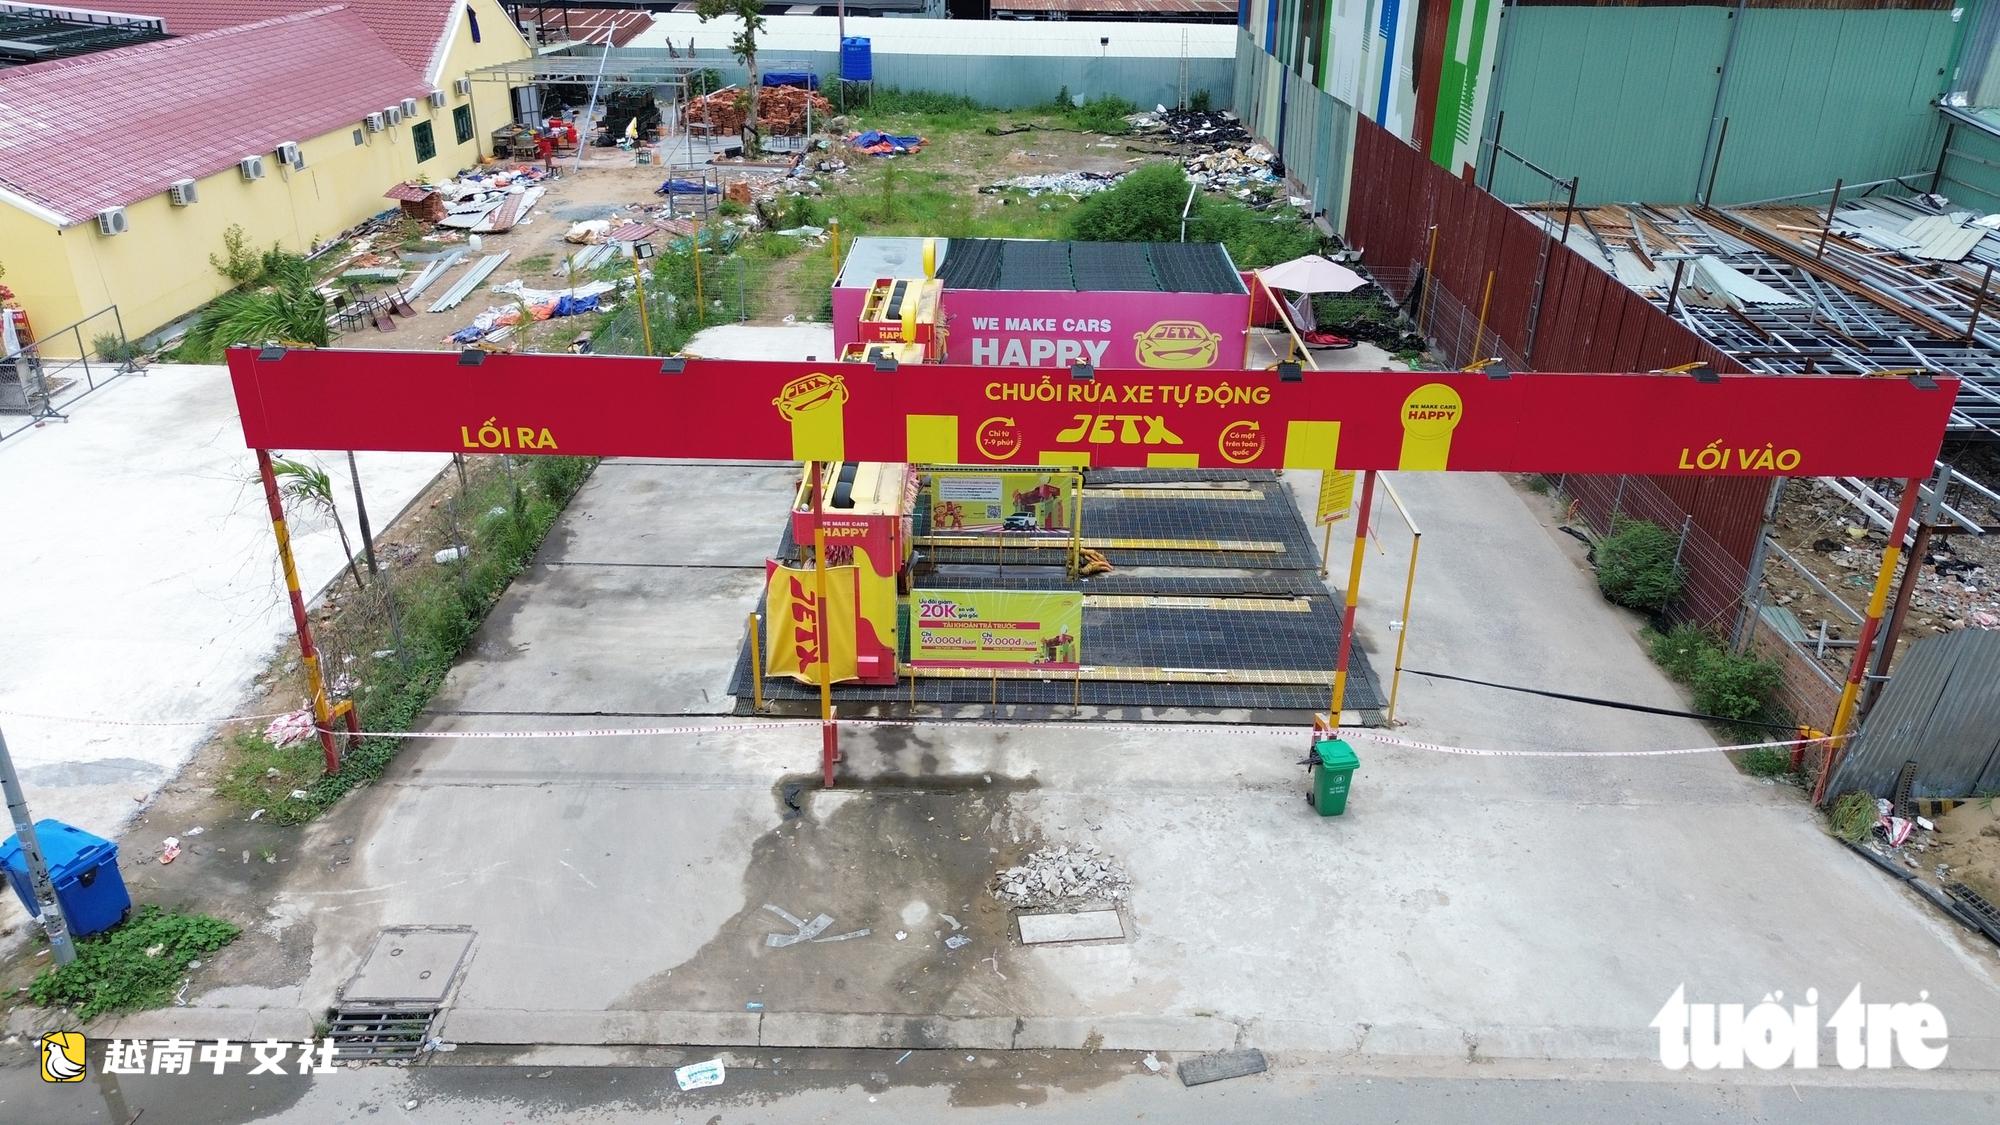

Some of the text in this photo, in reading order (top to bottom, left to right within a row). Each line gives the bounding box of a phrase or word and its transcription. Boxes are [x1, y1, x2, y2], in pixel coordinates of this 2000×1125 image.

[972, 317, 1112, 333] WE MAKE CARS
[1154, 327, 1202, 338] JETX
[972, 338, 1111, 367] HAPPY
[985, 376, 1271, 408] CHUỖI RỬA XE TỰ ĐỘNG
[1408, 410, 1455, 420] HAPPY
[461, 416, 558, 449] LỐI RA
[1056, 414, 1184, 445] JETX
[996, 439, 1014, 447] phút
[1678, 438, 1801, 471] LỐI VÀO
[823, 527, 869, 538] HAPPY
[920, 604, 957, 618] 20K
[790, 576, 818, 673] JETX
